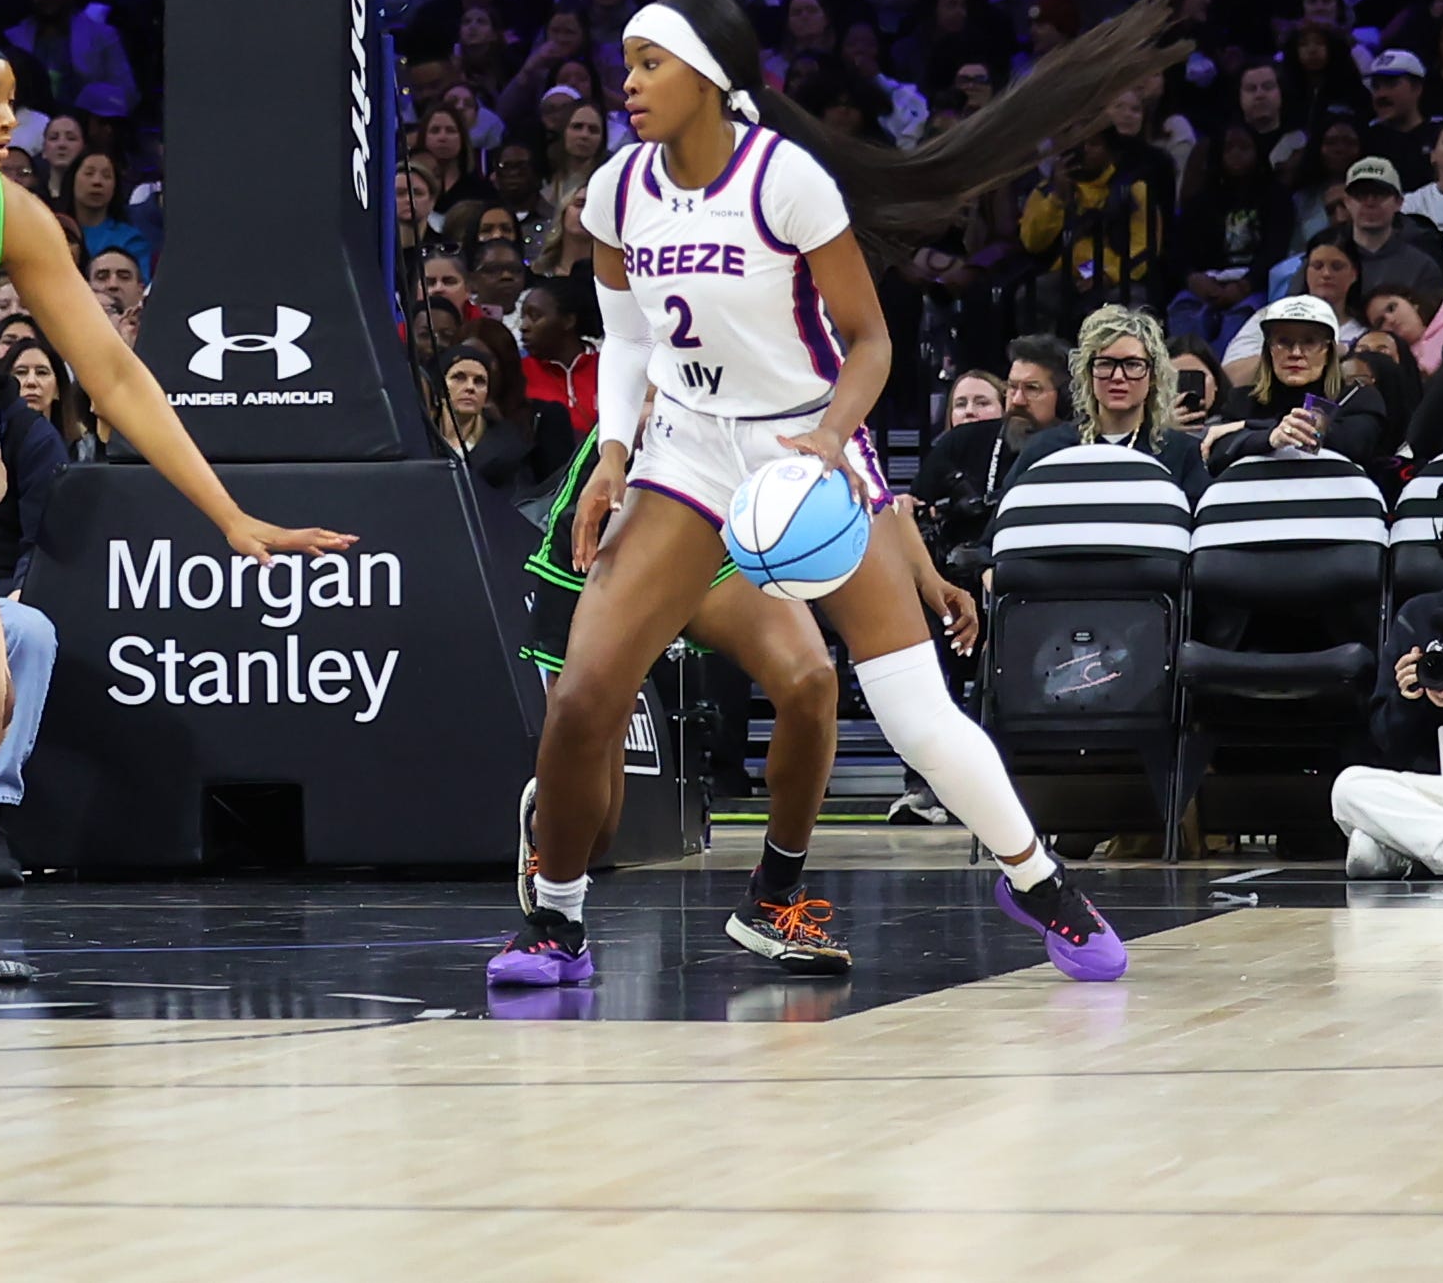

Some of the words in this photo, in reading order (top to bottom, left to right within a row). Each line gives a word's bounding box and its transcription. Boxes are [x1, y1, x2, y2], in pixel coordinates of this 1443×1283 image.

[710, 210, 746, 219] THORNE
[664, 294, 703, 350] 2
[169, 391, 238, 406] UNDER
[241, 390, 334, 406] ARMOUR
[676, 361, 724, 395] lly
[107, 538, 402, 629] Morgan
[106, 633, 401, 724] Stanley
